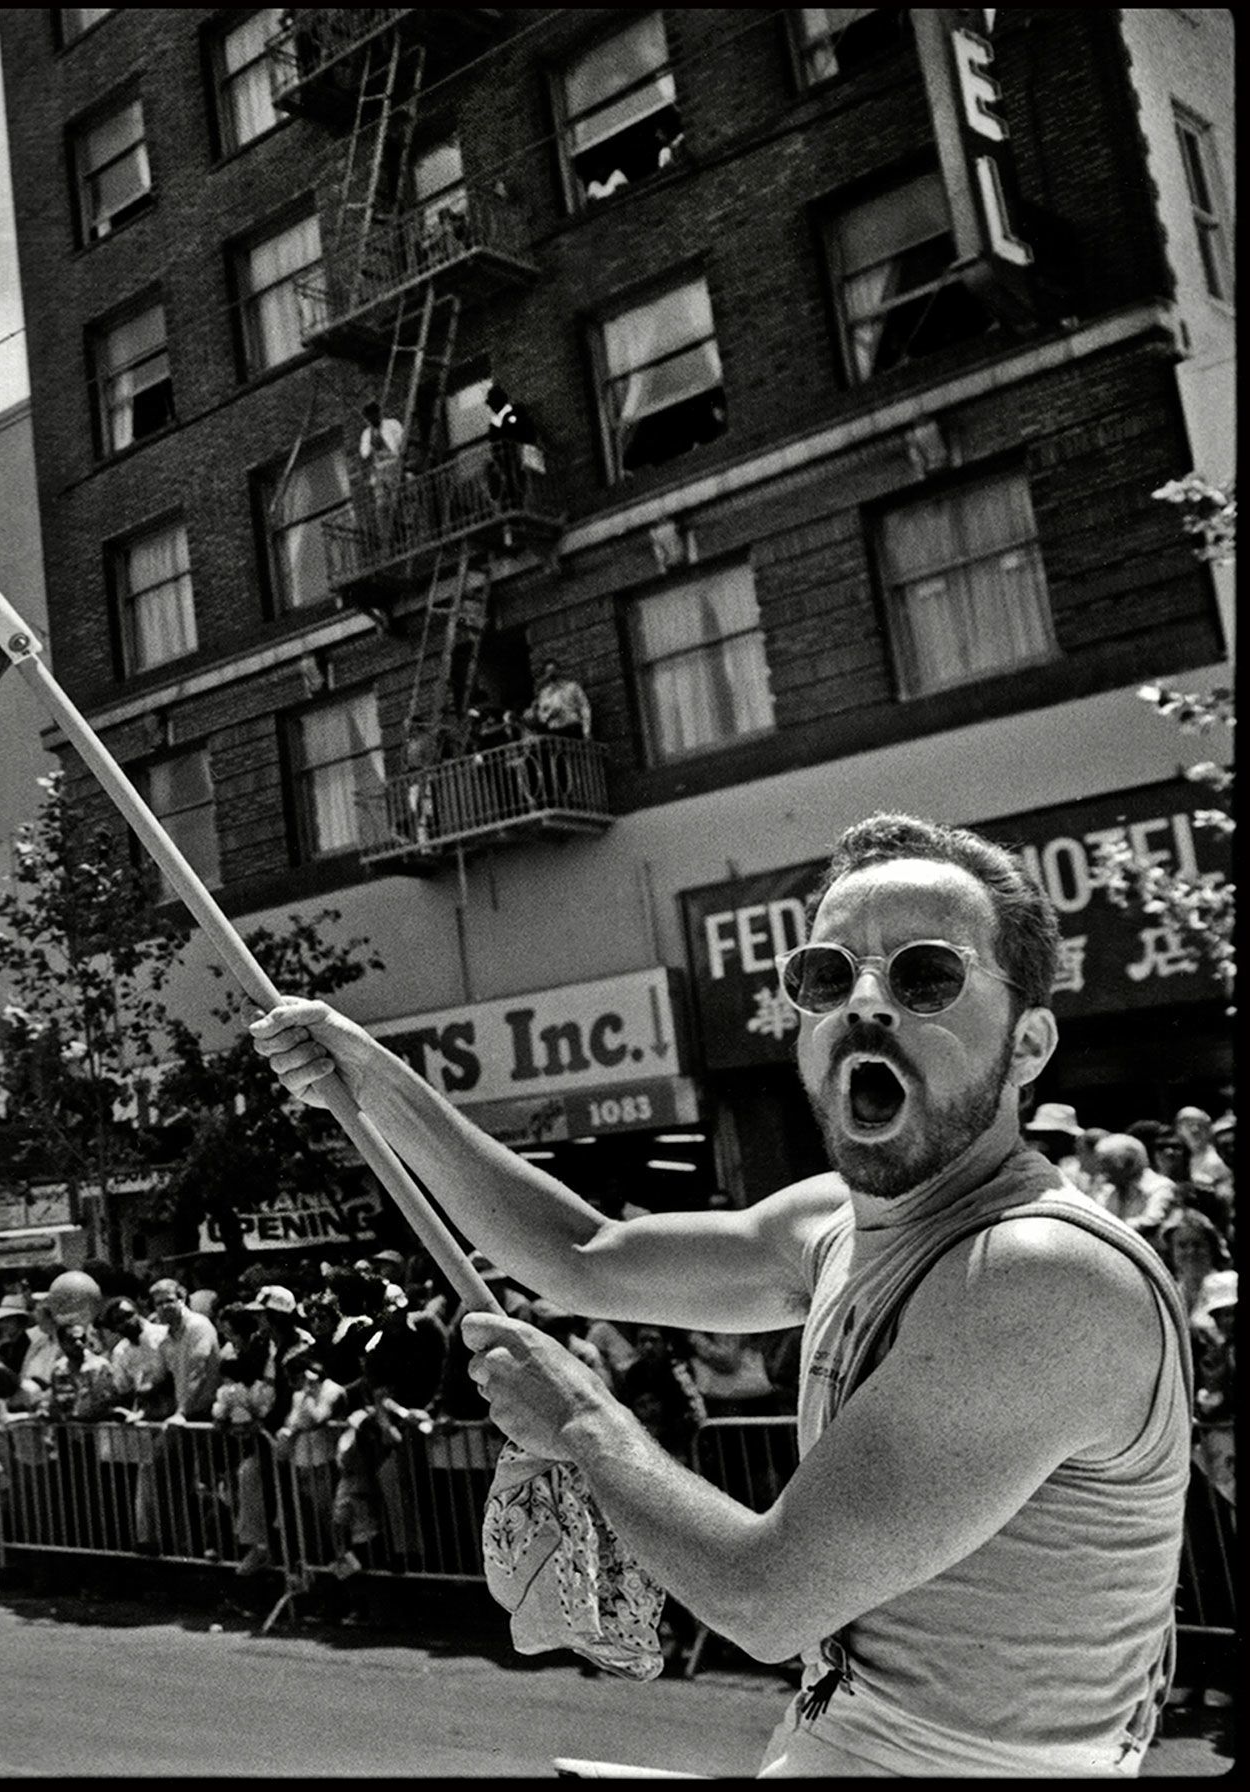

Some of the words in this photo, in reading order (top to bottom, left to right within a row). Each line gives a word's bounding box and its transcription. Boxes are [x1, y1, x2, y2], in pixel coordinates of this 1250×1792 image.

[952, 8, 1035, 267] EL
[374, 1019, 482, 1093] TS
[504, 1008, 644, 1083] Inc.
